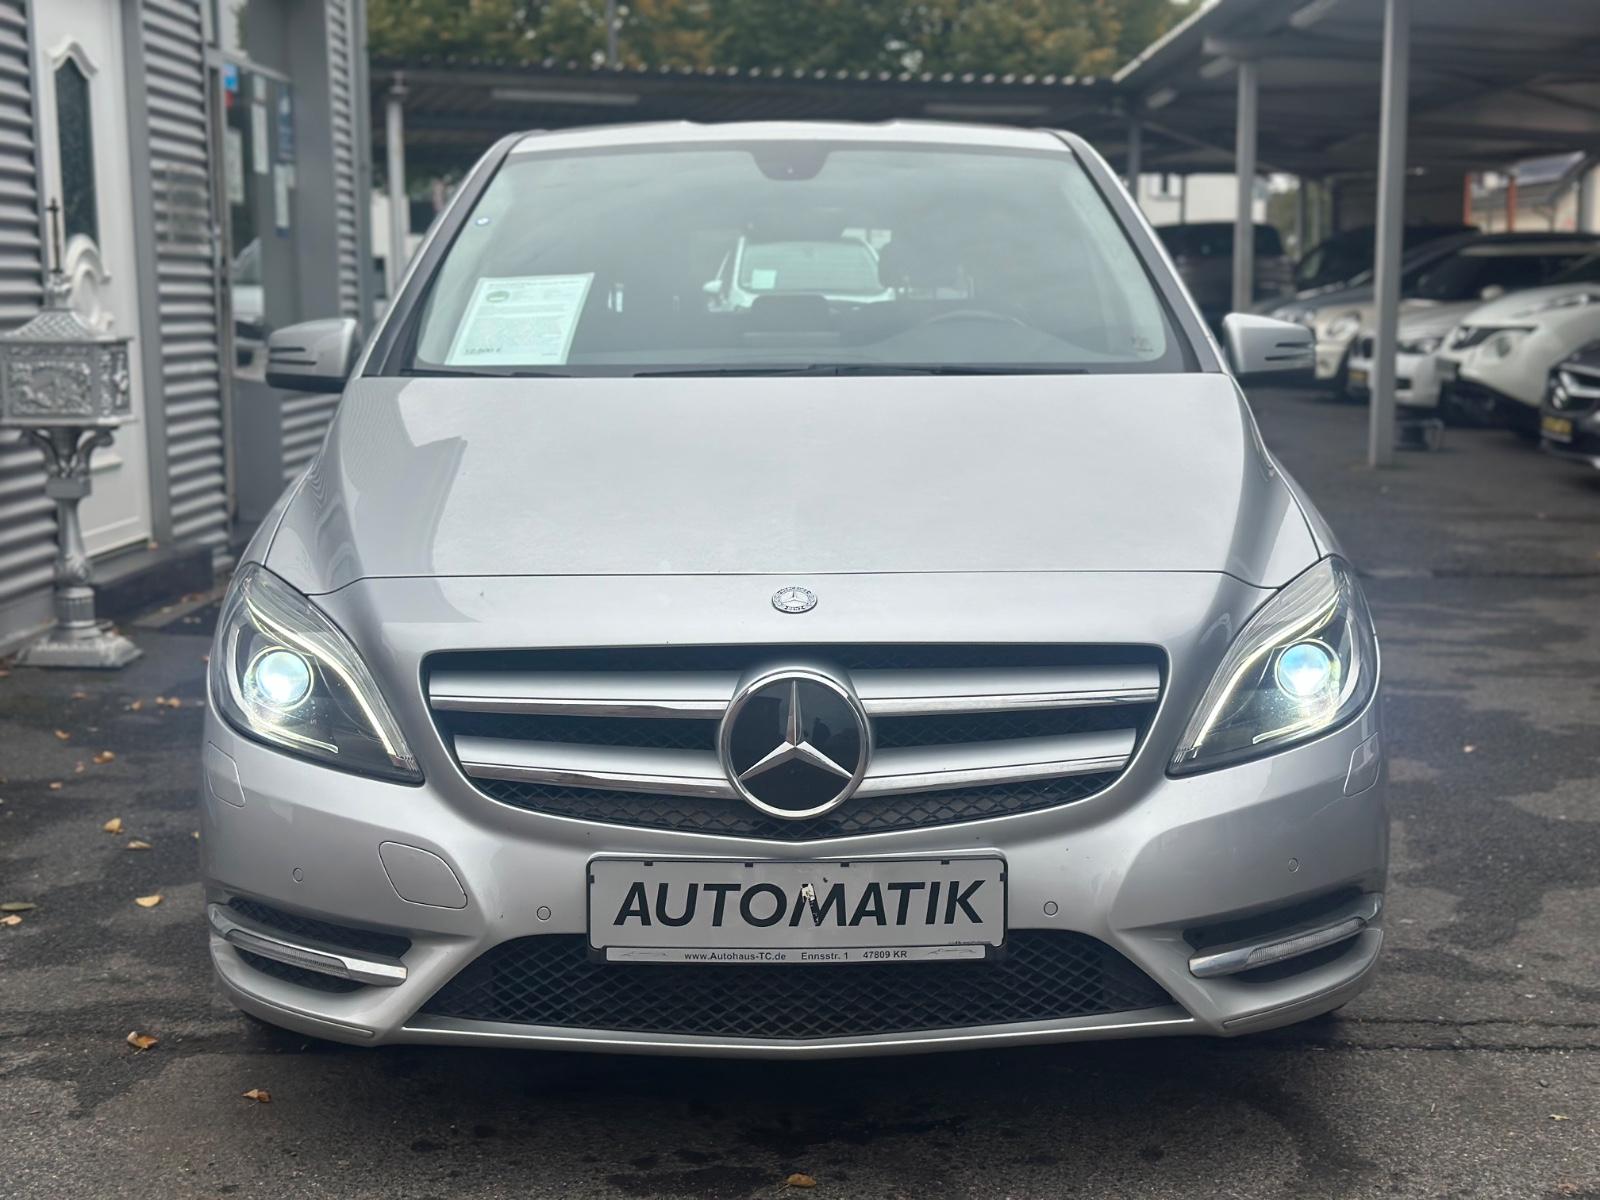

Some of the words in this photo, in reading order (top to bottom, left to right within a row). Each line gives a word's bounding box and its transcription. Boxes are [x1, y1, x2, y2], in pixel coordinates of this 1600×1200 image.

[611, 879, 986, 928] AUTOMATIK
[683, 951, 787, 961] www.Autohaus-TC.de
[801, 951, 841, 961] Ennsstr.
[862, 950, 891, 959] 47809
[893, 950, 908, 959] KR
